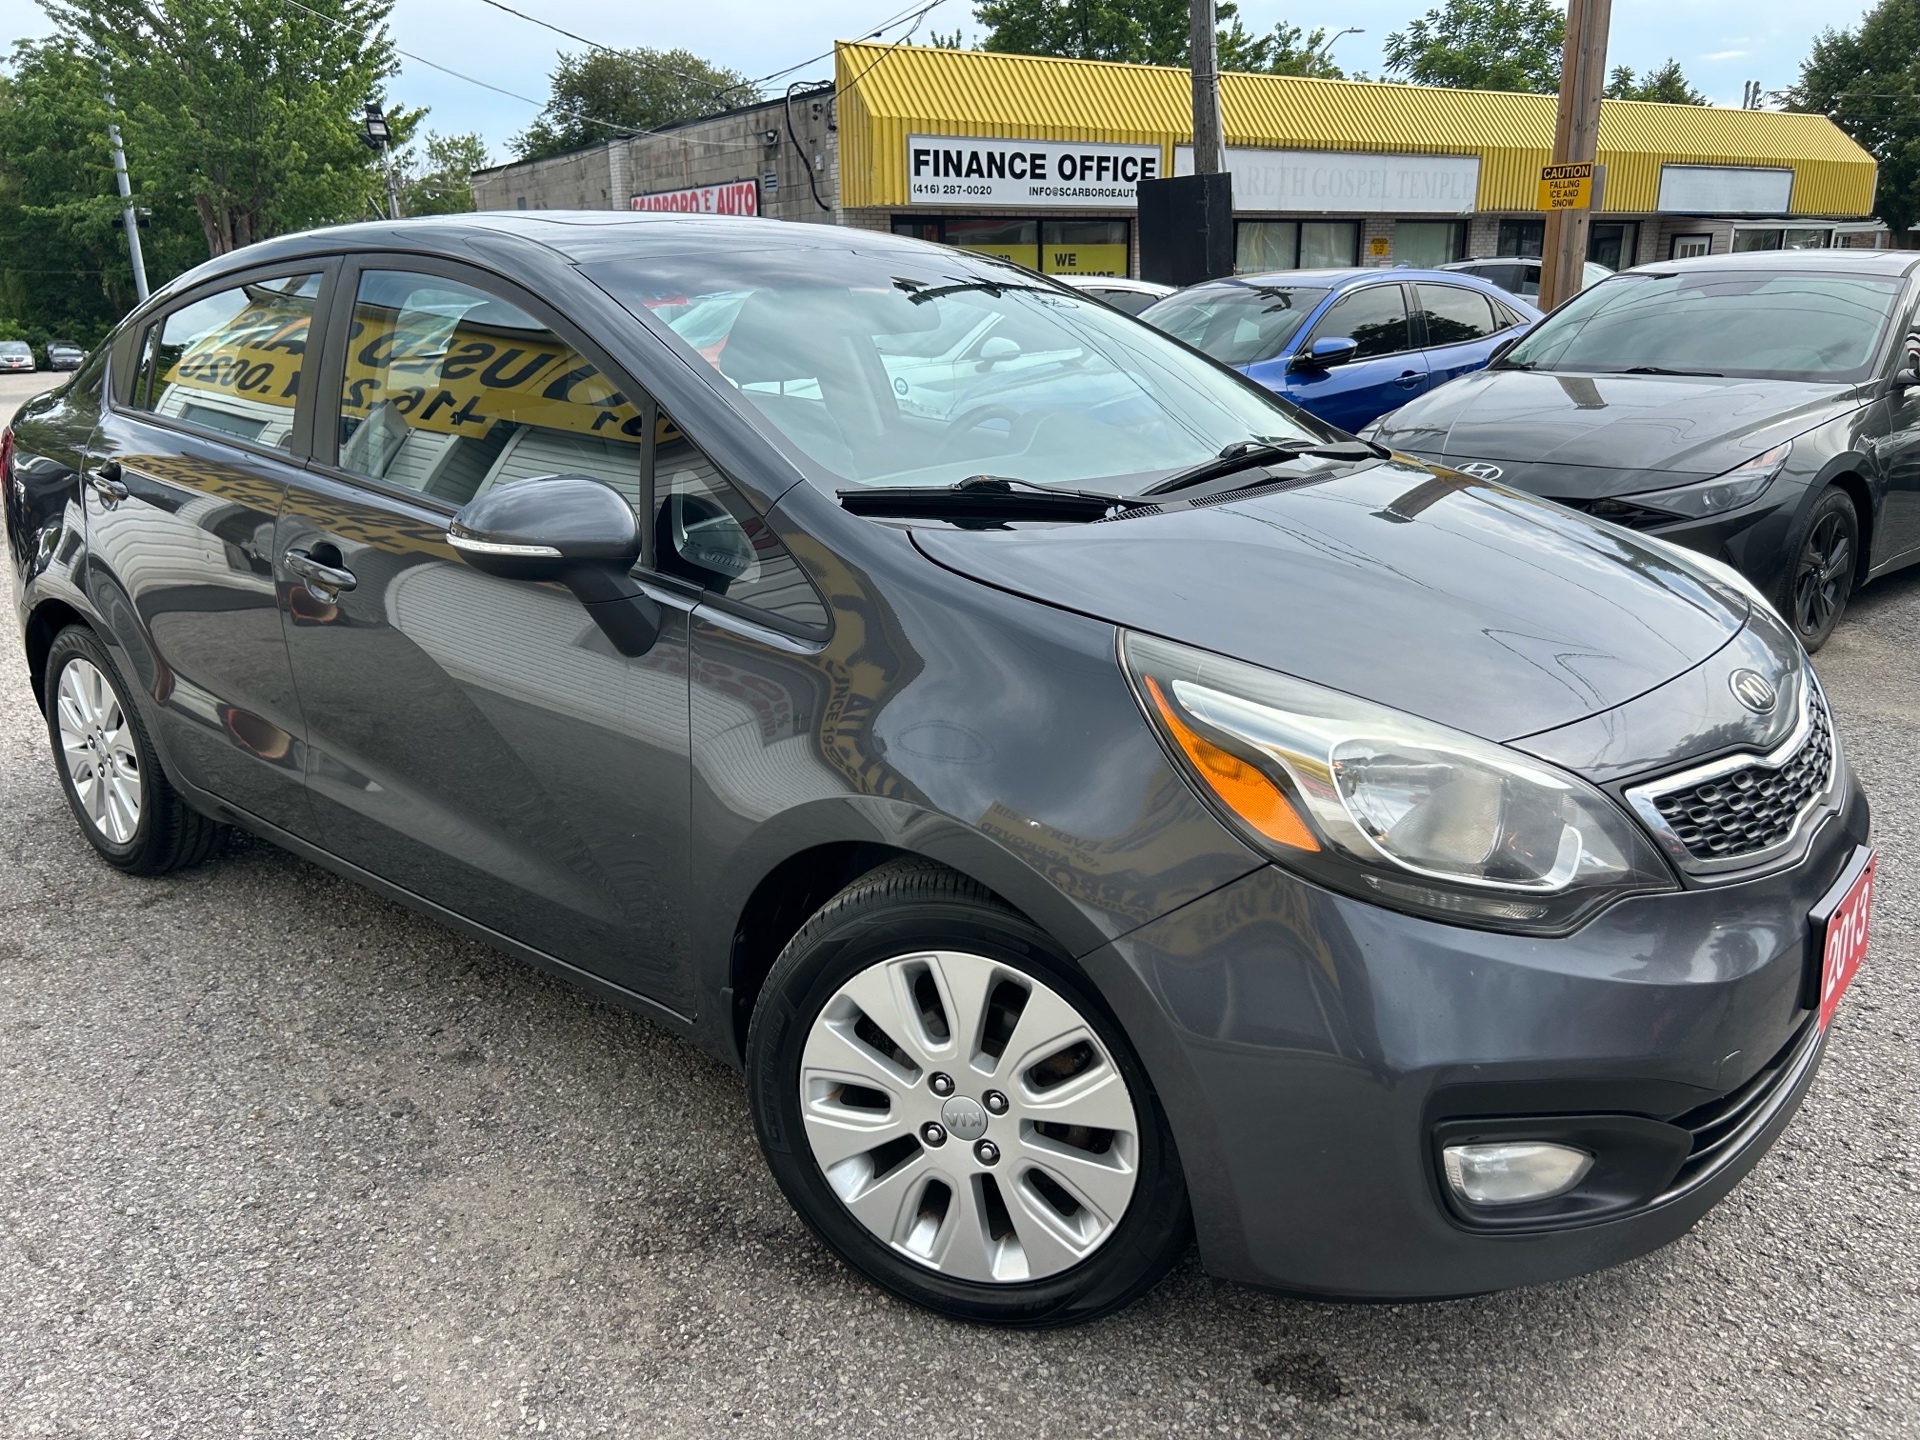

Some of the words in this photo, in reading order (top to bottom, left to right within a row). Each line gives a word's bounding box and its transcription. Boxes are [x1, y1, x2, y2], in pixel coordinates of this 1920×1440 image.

[913, 148, 1046, 180] FINANCE
[1057, 153, 1156, 183] OFFICE
[1543, 165, 1590, 179] CAUTION
[1311, 167, 1392, 199] GOSPEL
[1397, 169, 1474, 200] TEMPLE
[1549, 180, 1580, 189] FALLING
[913, 184, 940, 195] (416)
[943, 184, 992, 195] 287-0020
[1029, 186, 1138, 198] INFO@SCARBOROEAUT
[1549, 190, 1562, 198] ICE
[1562, 189, 1579, 198] AND
[716, 182, 756, 216] AUTO
[1551, 198, 1575, 208] SNOW
[1054, 253, 1077, 267] WE
[1824, 881, 1870, 1003] 2013
